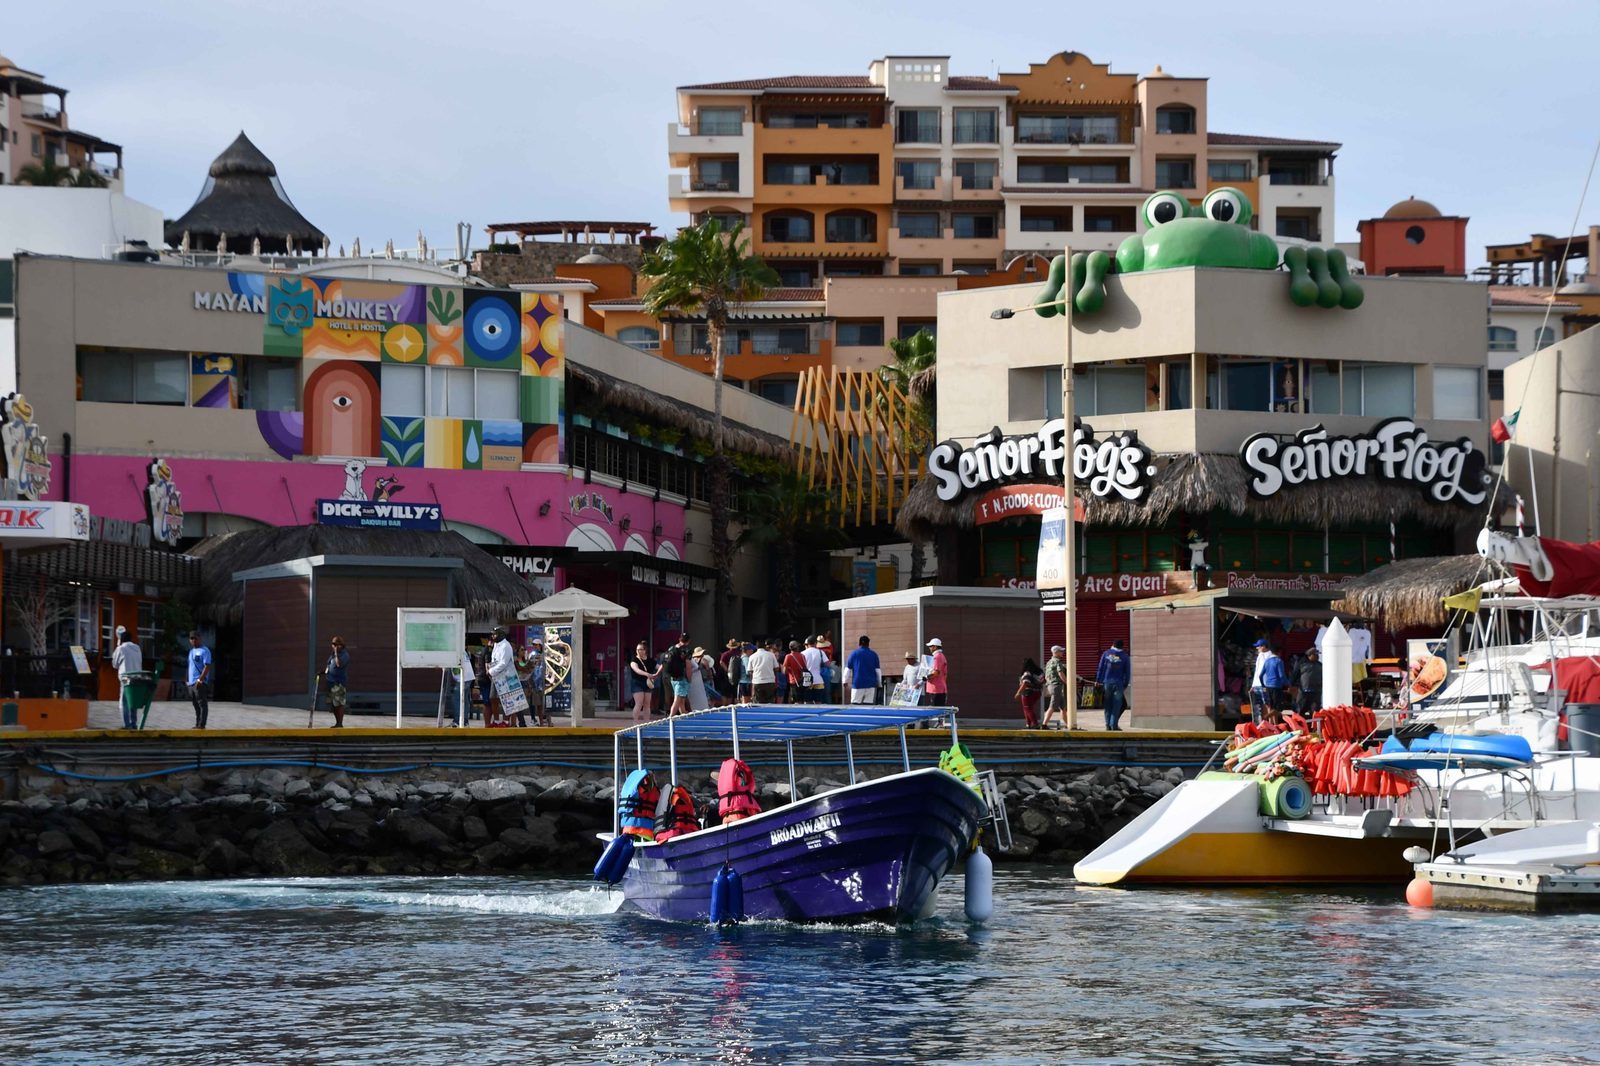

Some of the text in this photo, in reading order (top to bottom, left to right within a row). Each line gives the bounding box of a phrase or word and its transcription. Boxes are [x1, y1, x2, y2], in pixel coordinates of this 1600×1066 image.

[194, 291, 267, 313] MAYAN
[317, 300, 402, 321] MONKEY
[329, 321, 352, 330] HOTEL
[360, 323, 387, 332] HOSTEL
[928, 431, 1041, 501] Señor
[1244, 429, 1380, 496] Señor
[322, 502, 362, 517] DICK
[373, 505, 439, 520] WILLY'S
[388, 519, 401, 527] BAR
[496, 556, 553, 573] RMACY
[1084, 577, 1112, 593] Are
[1119, 573, 1168, 597] Open!
